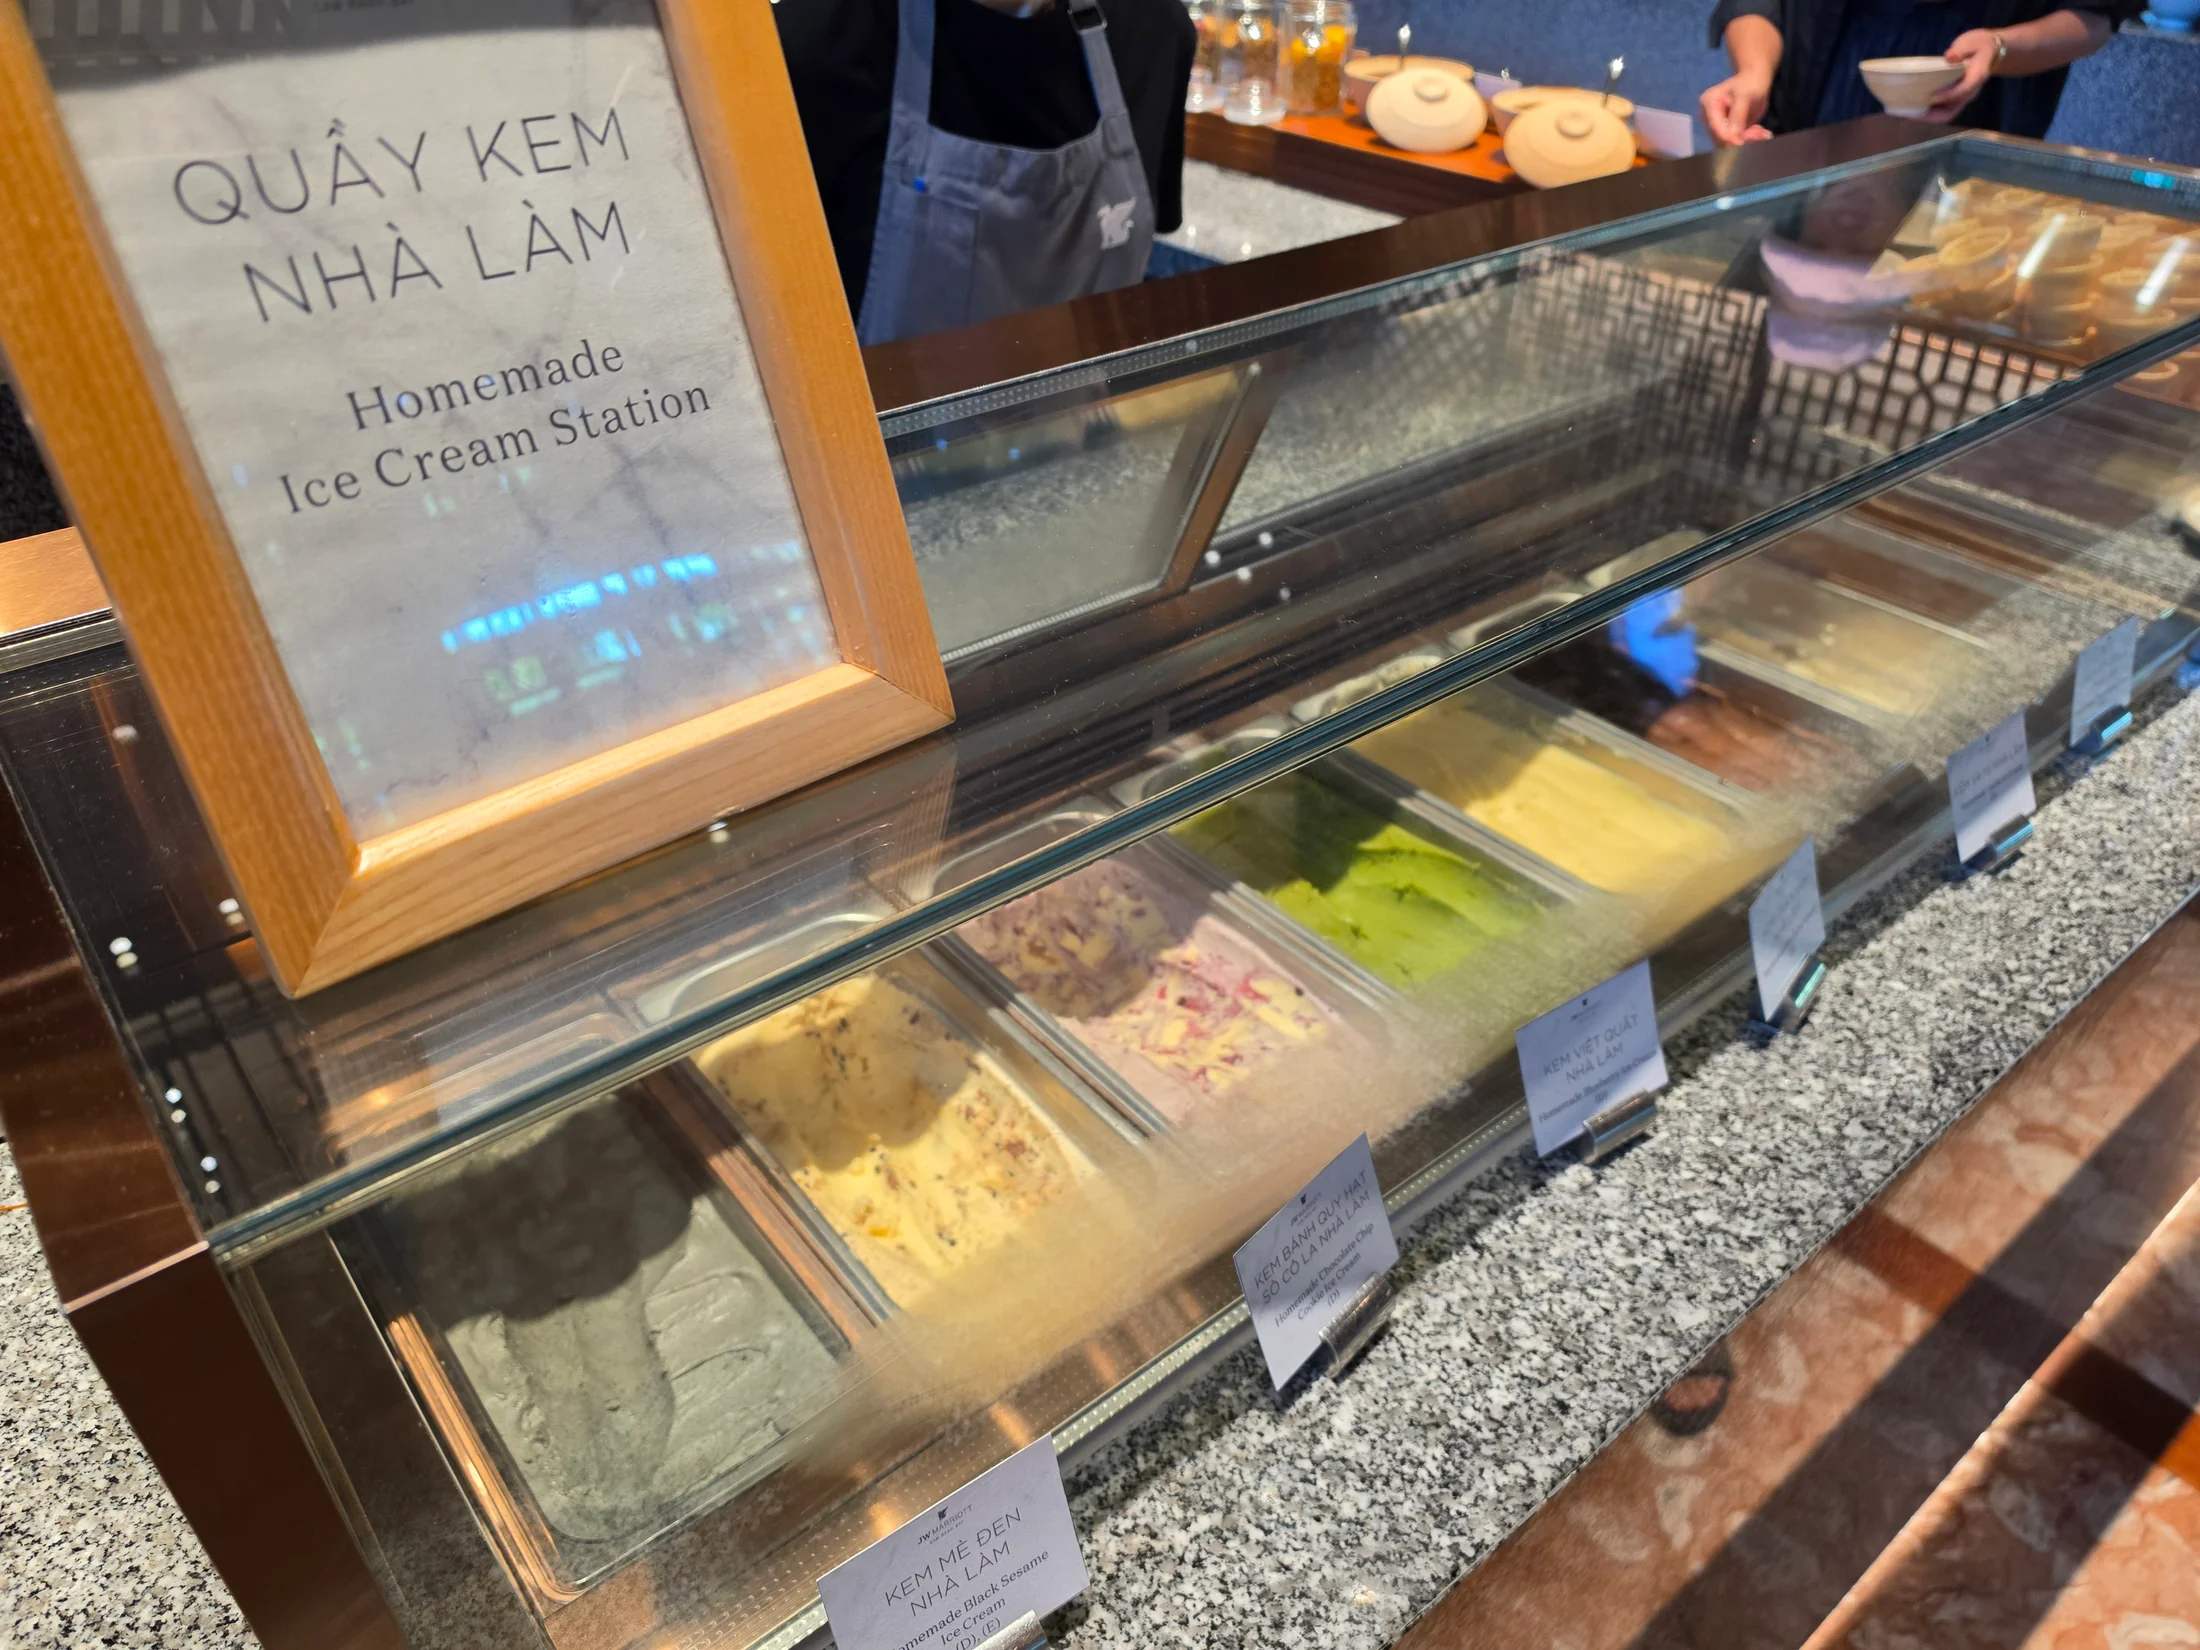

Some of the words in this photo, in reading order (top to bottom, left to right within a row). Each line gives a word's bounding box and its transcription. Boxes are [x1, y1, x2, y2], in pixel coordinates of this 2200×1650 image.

[174, 117, 426, 225] QUẦY
[466, 107, 630, 183] KEM
[243, 222, 443, 323] NHÀ
[466, 199, 630, 280] LÀM
[346, 338, 626, 431] Homemade
[279, 473, 362, 514] Ice
[374, 427, 539, 489] Cream
[548, 386, 712, 447] Station
[1543, 1052, 1572, 1076] KEM
[1254, 1256, 1281, 1289] KEM
[1282, 1221, 1317, 1261] BÁNH
[1262, 1280, 1280, 1304] SÔ
[1282, 1259, 1300, 1283] CÔ
[1301, 1243, 1318, 1265] LA
[1274, 1278, 1320, 1327] Homemade
[1318, 1240, 1357, 1281] Chocolate
[1355, 1222, 1374, 1243] Chip
[1297, 1289, 1324, 1320] Cookie
[1335, 1252, 1362, 1281] Cream
[884, 1564, 933, 1606] KEM
[938, 1540, 972, 1572] MÈ
[976, 1507, 1022, 1547] ĐEN
[917, 1530, 932, 1545] JW
[931, 1504, 973, 1535] MARRIOTT
[892, 1610, 962, 1650] memade
[963, 1583, 1000, 1612] Black
[1000, 1551, 1049, 1587] Sesame
[910, 1574, 960, 1617] NHÀ
[964, 1541, 1010, 1581] LÀM
[940, 1628, 961, 1646] Ice
[963, 1598, 1006, 1630] Cream
[982, 1617, 1001, 1637] (E)
